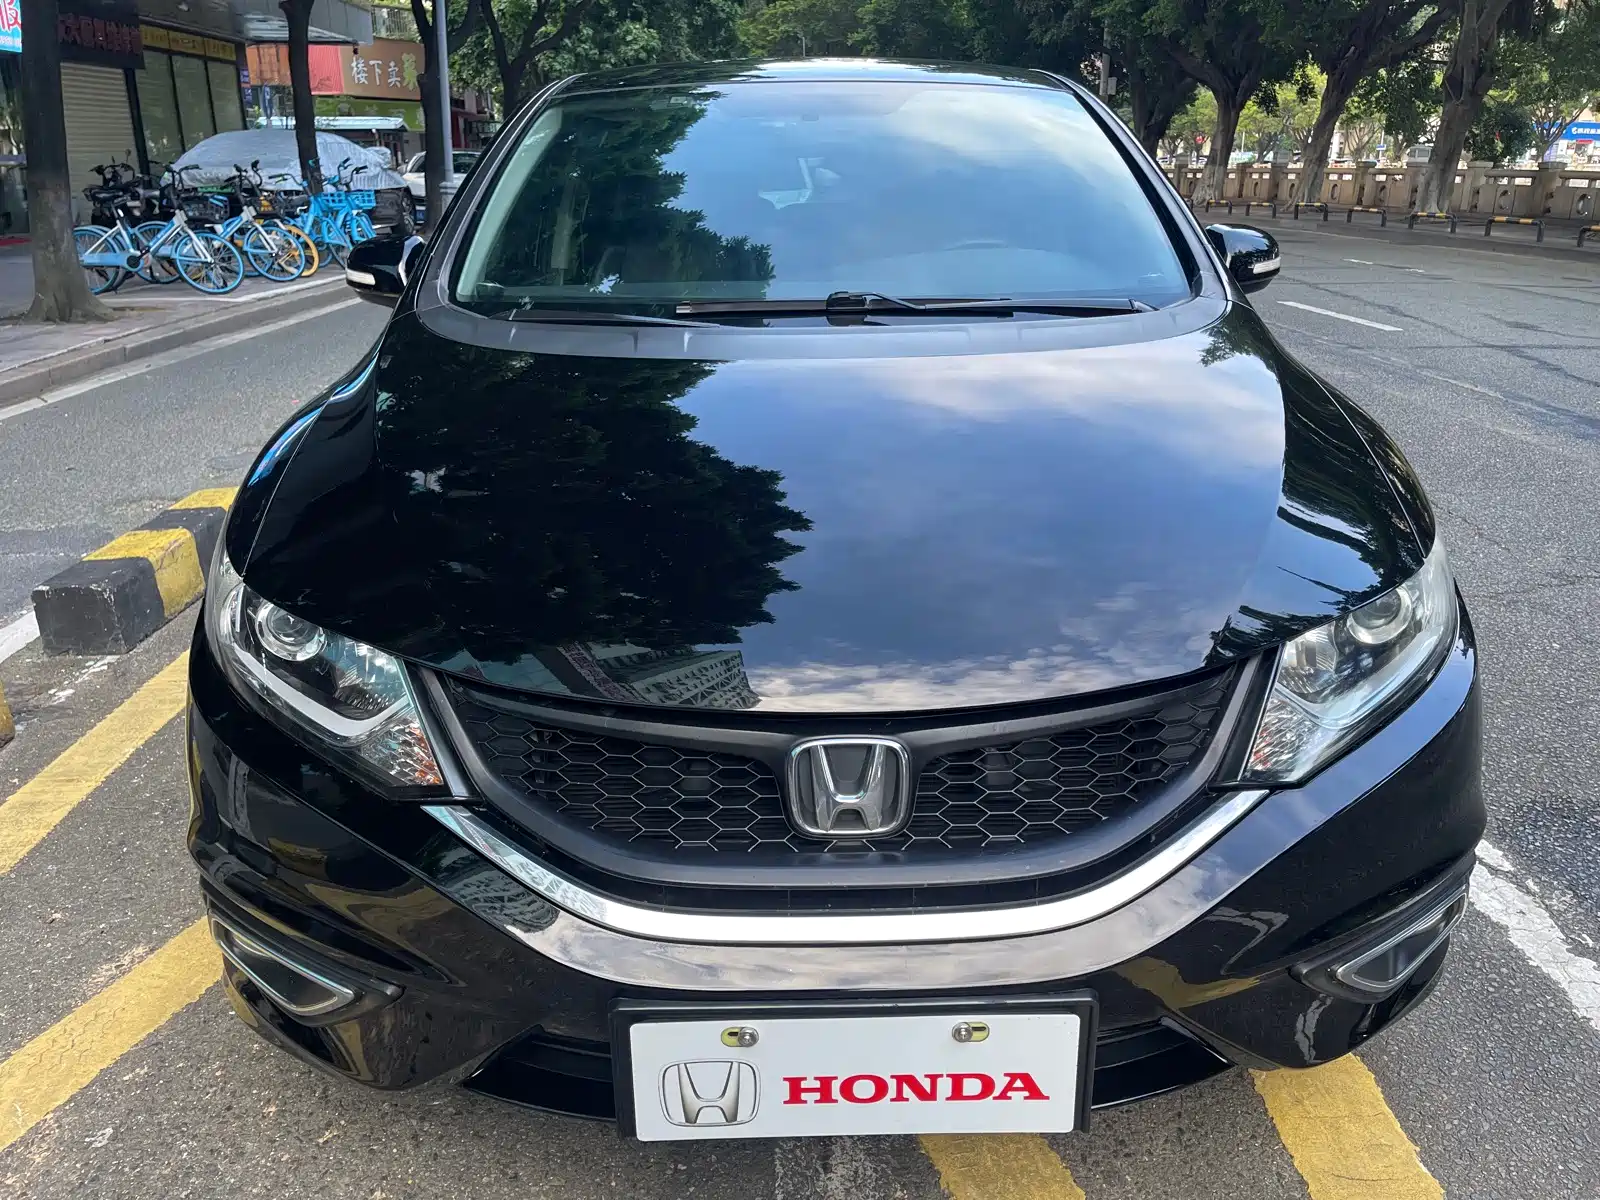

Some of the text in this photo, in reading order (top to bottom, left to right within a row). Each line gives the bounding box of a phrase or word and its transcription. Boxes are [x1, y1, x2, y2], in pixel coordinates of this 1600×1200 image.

[351, 53, 418, 91] 楼下卖菜
[782, 1072, 1050, 1105] HONDA
